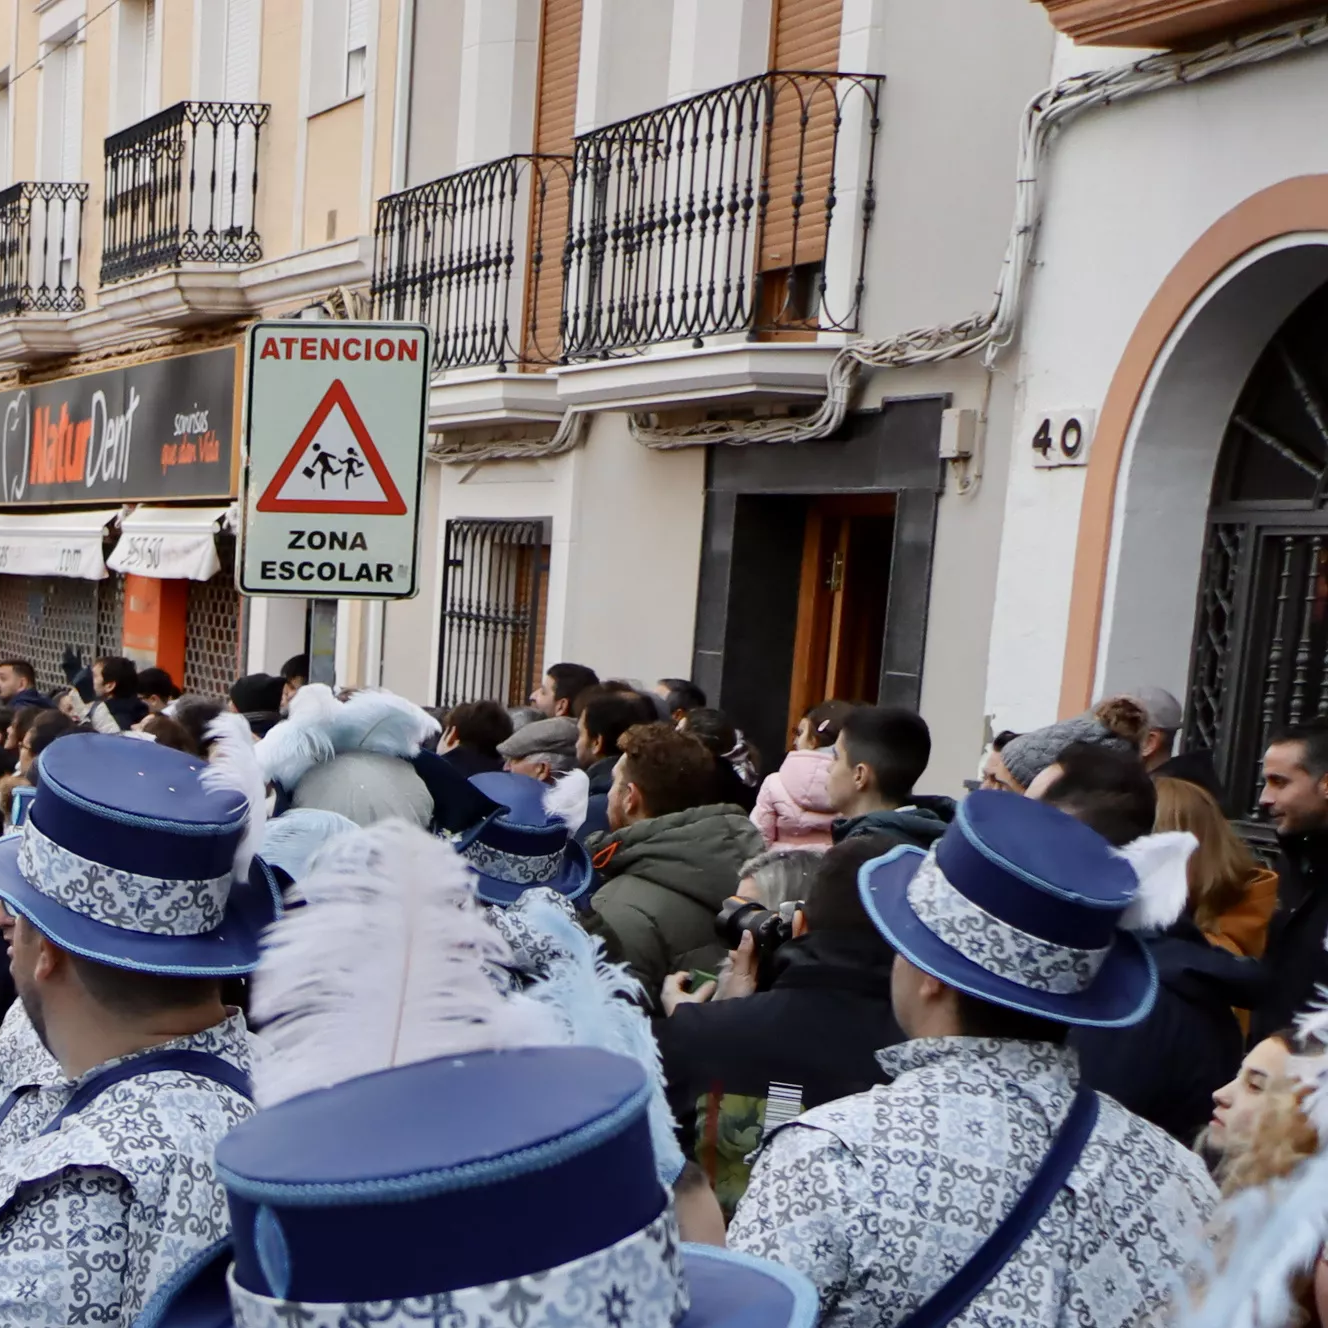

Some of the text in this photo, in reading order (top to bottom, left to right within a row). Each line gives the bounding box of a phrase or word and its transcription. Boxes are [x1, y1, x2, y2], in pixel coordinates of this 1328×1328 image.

[259, 337, 418, 361] ATENCION
[1032, 417, 1082, 457] 40
[287, 530, 368, 551] ZONA
[260, 561, 394, 583] ESCOLAR
